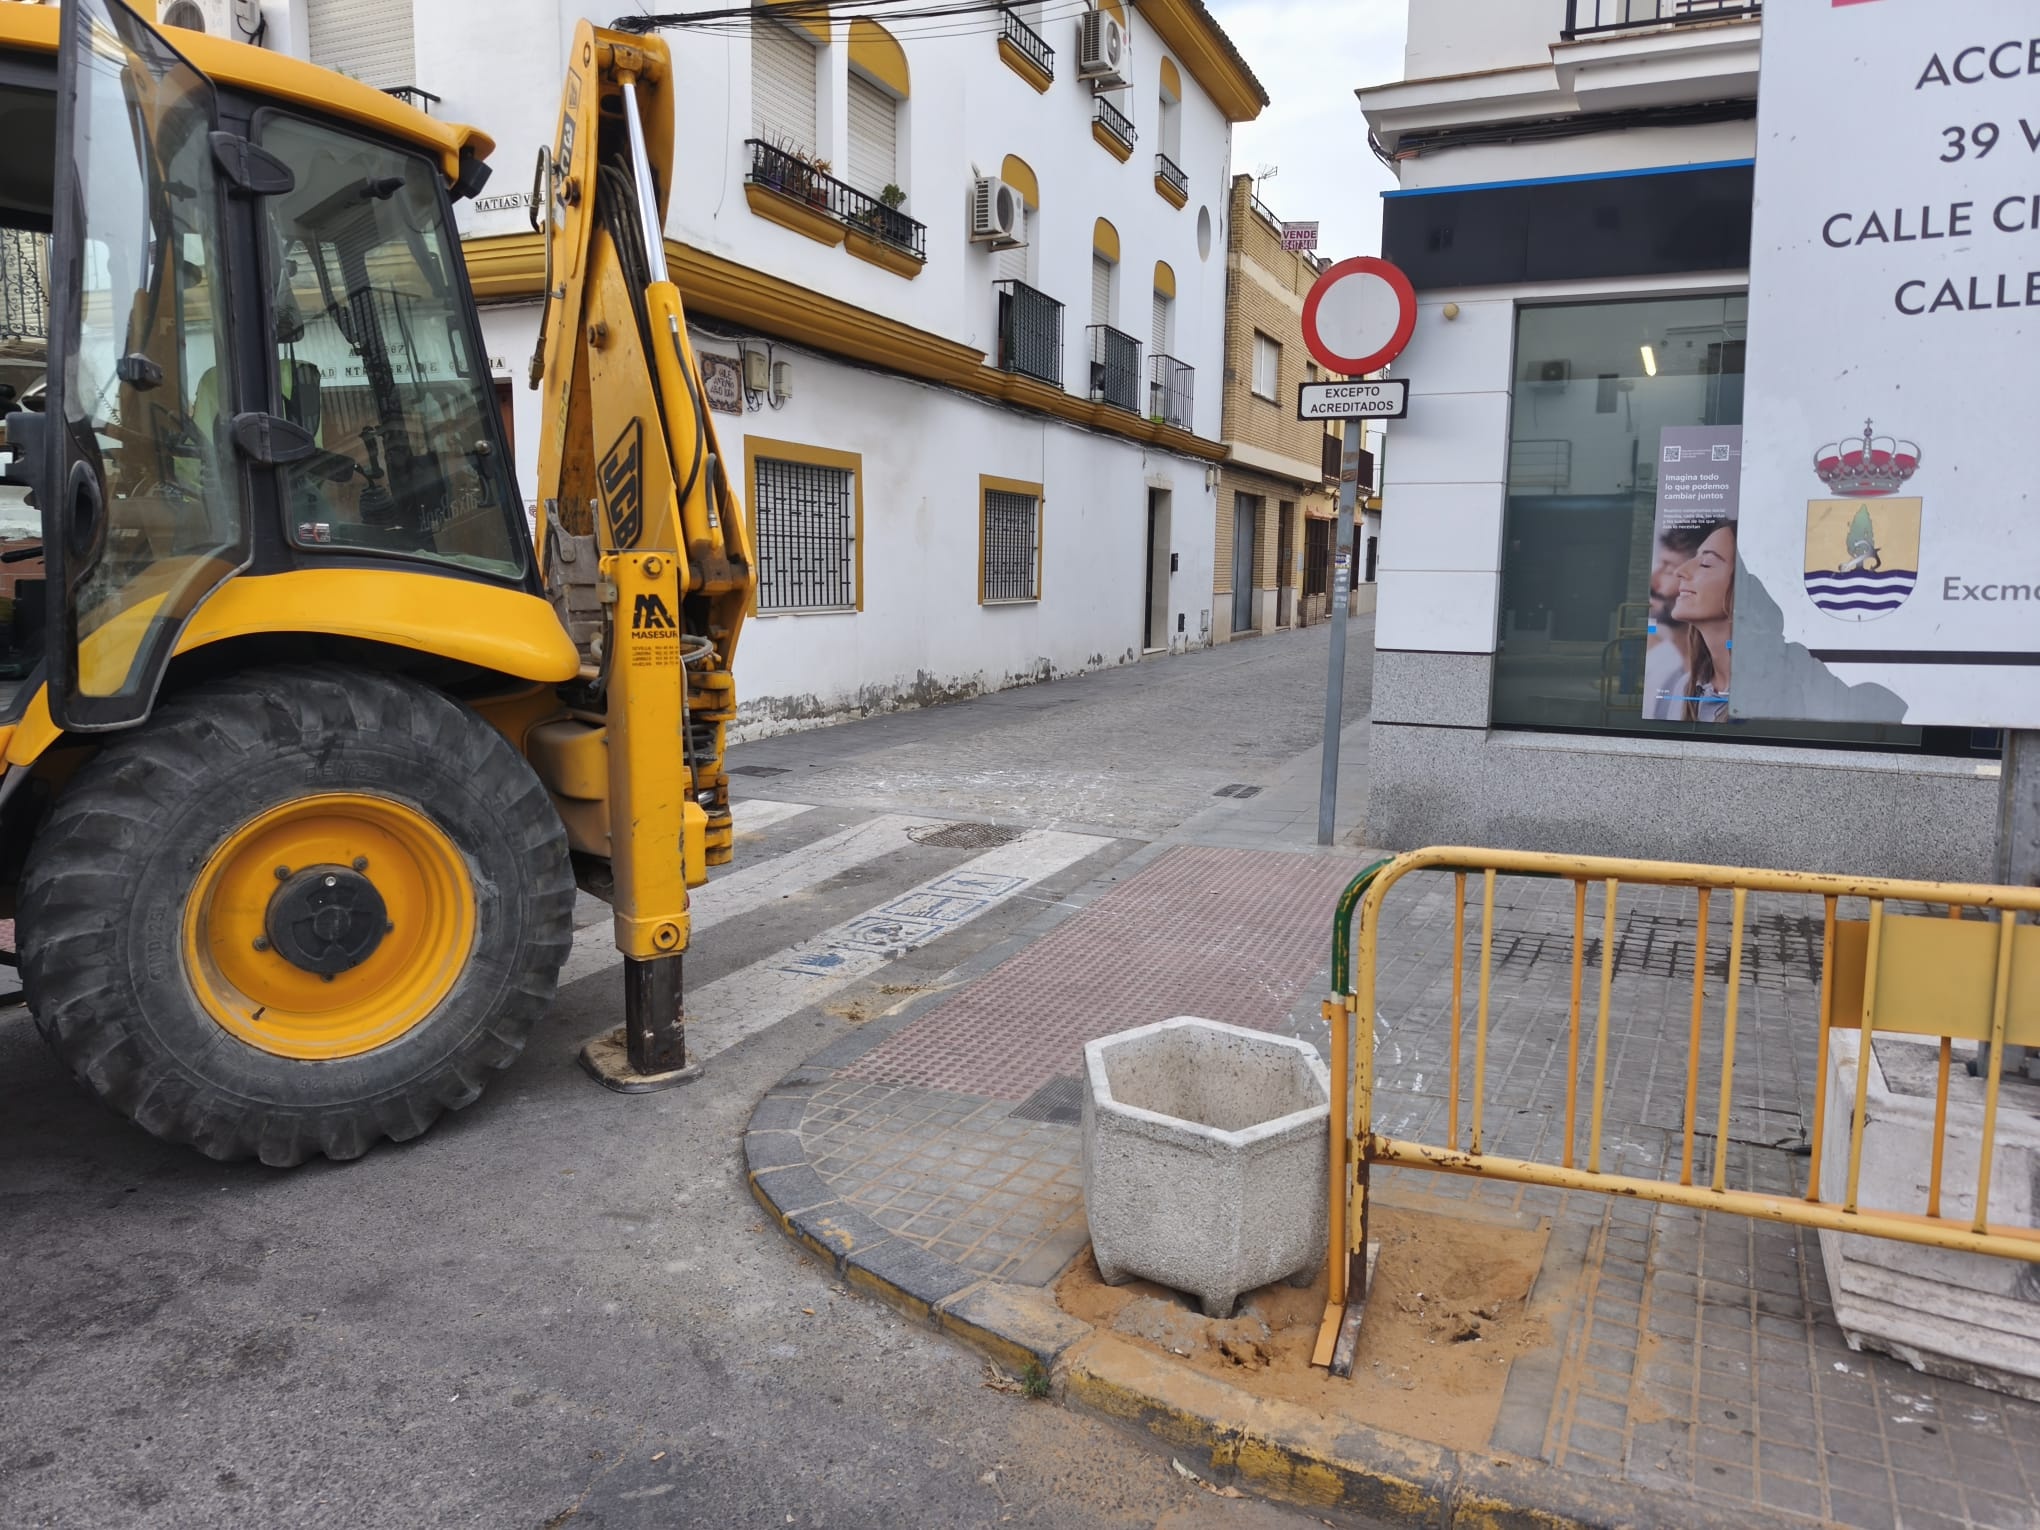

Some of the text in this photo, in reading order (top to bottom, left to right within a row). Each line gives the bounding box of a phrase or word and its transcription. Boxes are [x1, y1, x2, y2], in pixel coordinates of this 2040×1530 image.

[1939, 121, 2000, 163] 39
[475, 196, 519, 211] MATIAS
[1821, 201, 1974, 249] CALLE
[1283, 230, 1317, 239] VENDE
[1894, 271, 2040, 316] CALLE
[1326, 386, 1380, 398] EXCEPTO
[1310, 401, 1394, 413] ACREDITADOS
[1665, 473, 1719, 482] Imagina todo
[1692, 483, 1729, 491] podemos
[603, 441, 637, 548] JCB
[1664, 492, 1724, 501] cambiar juntos
[632, 630, 678, 640] MASESUR
